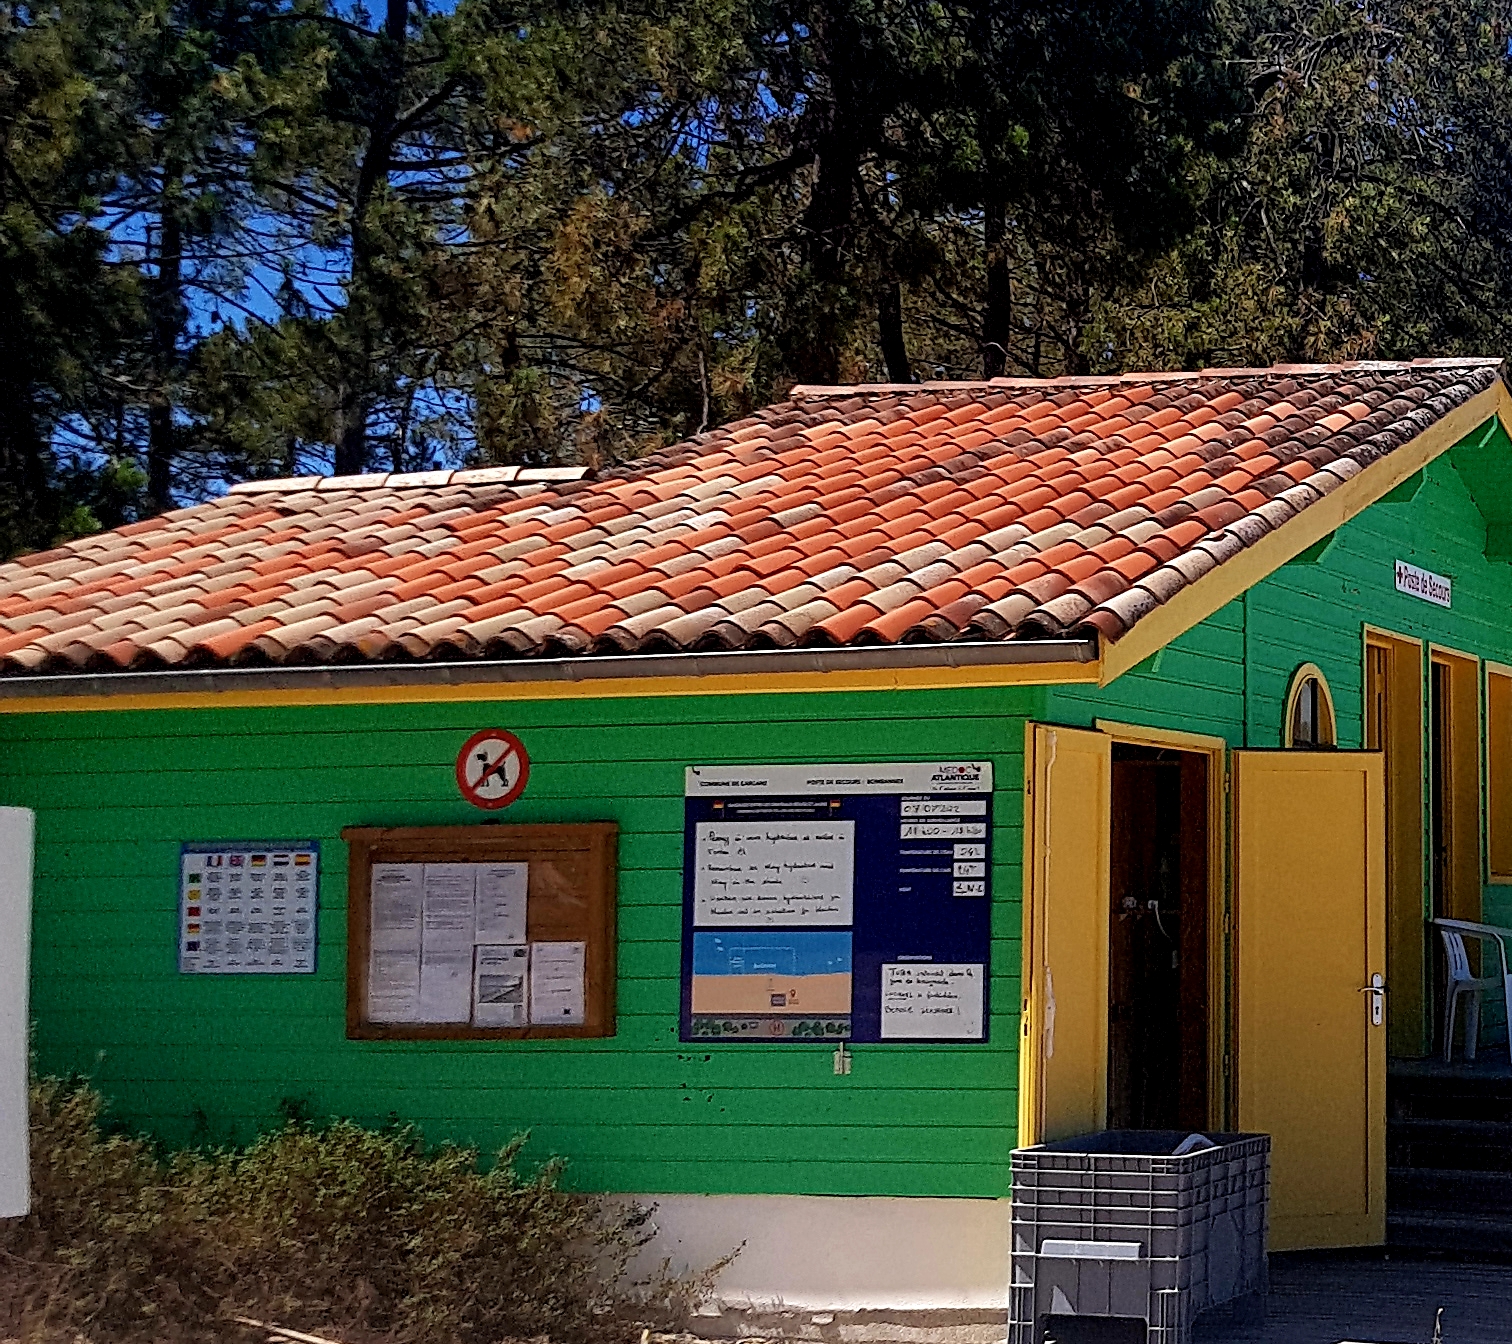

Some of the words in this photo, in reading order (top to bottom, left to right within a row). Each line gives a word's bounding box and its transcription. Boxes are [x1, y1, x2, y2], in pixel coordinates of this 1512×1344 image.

[1404, 565, 1419, 592] Poste
[1421, 573, 1428, 594] de
[1429, 575, 1449, 602] Secours
